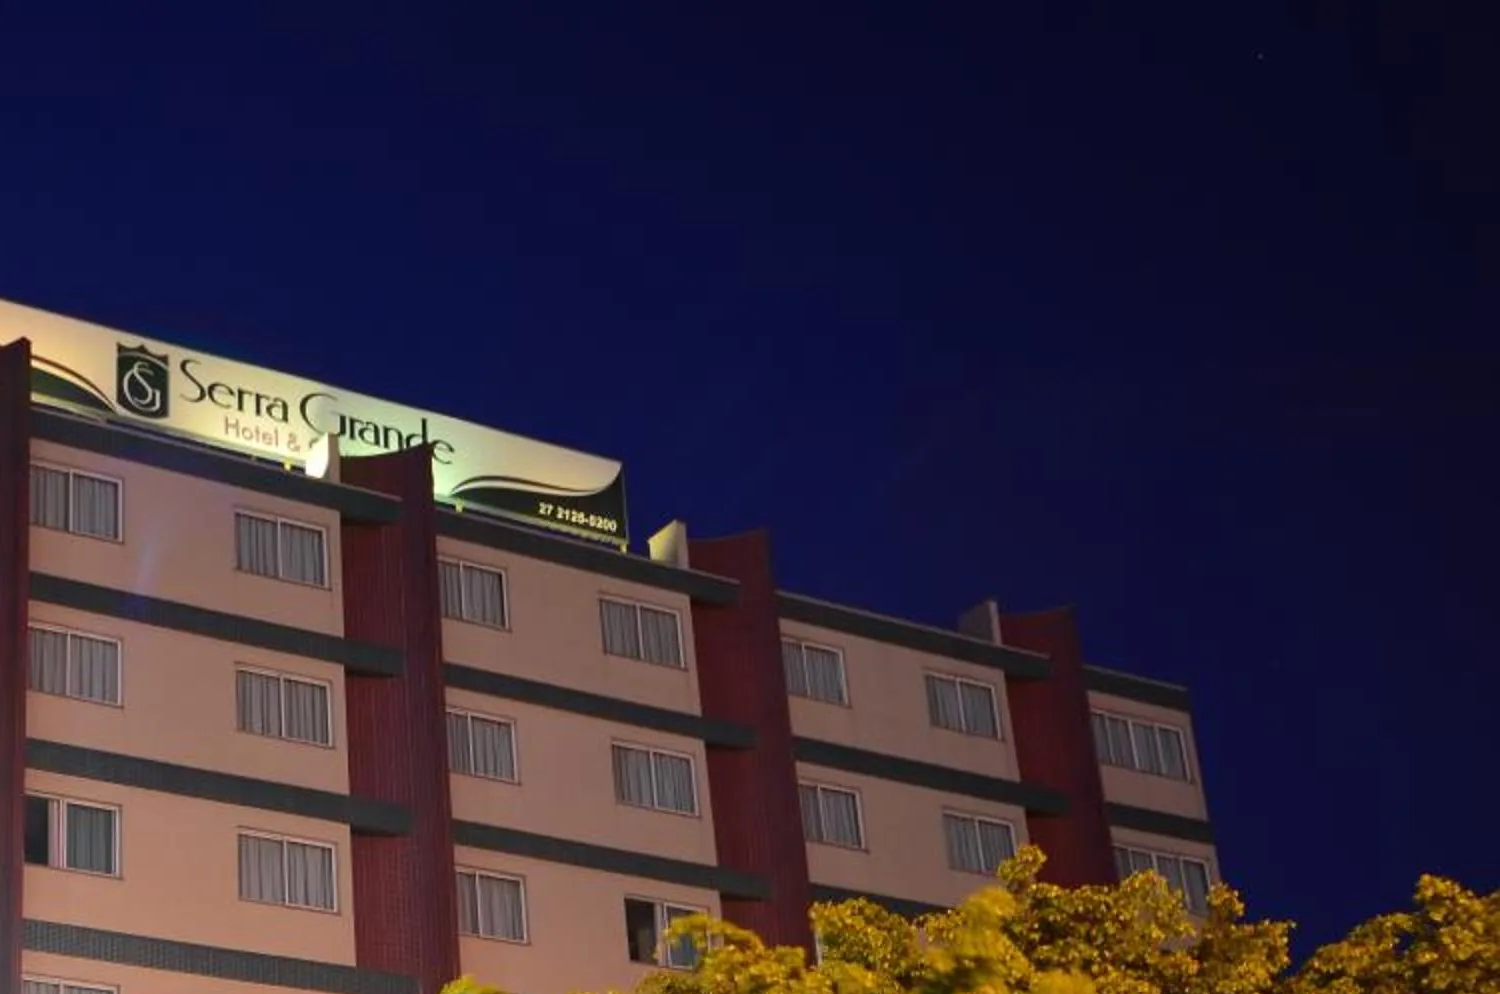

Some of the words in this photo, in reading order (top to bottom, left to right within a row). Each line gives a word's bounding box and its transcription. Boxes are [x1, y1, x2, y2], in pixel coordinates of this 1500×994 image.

[179, 358, 290, 423] Serra
[299, 391, 456, 466] Grande
[223, 415, 281, 448] Hotel
